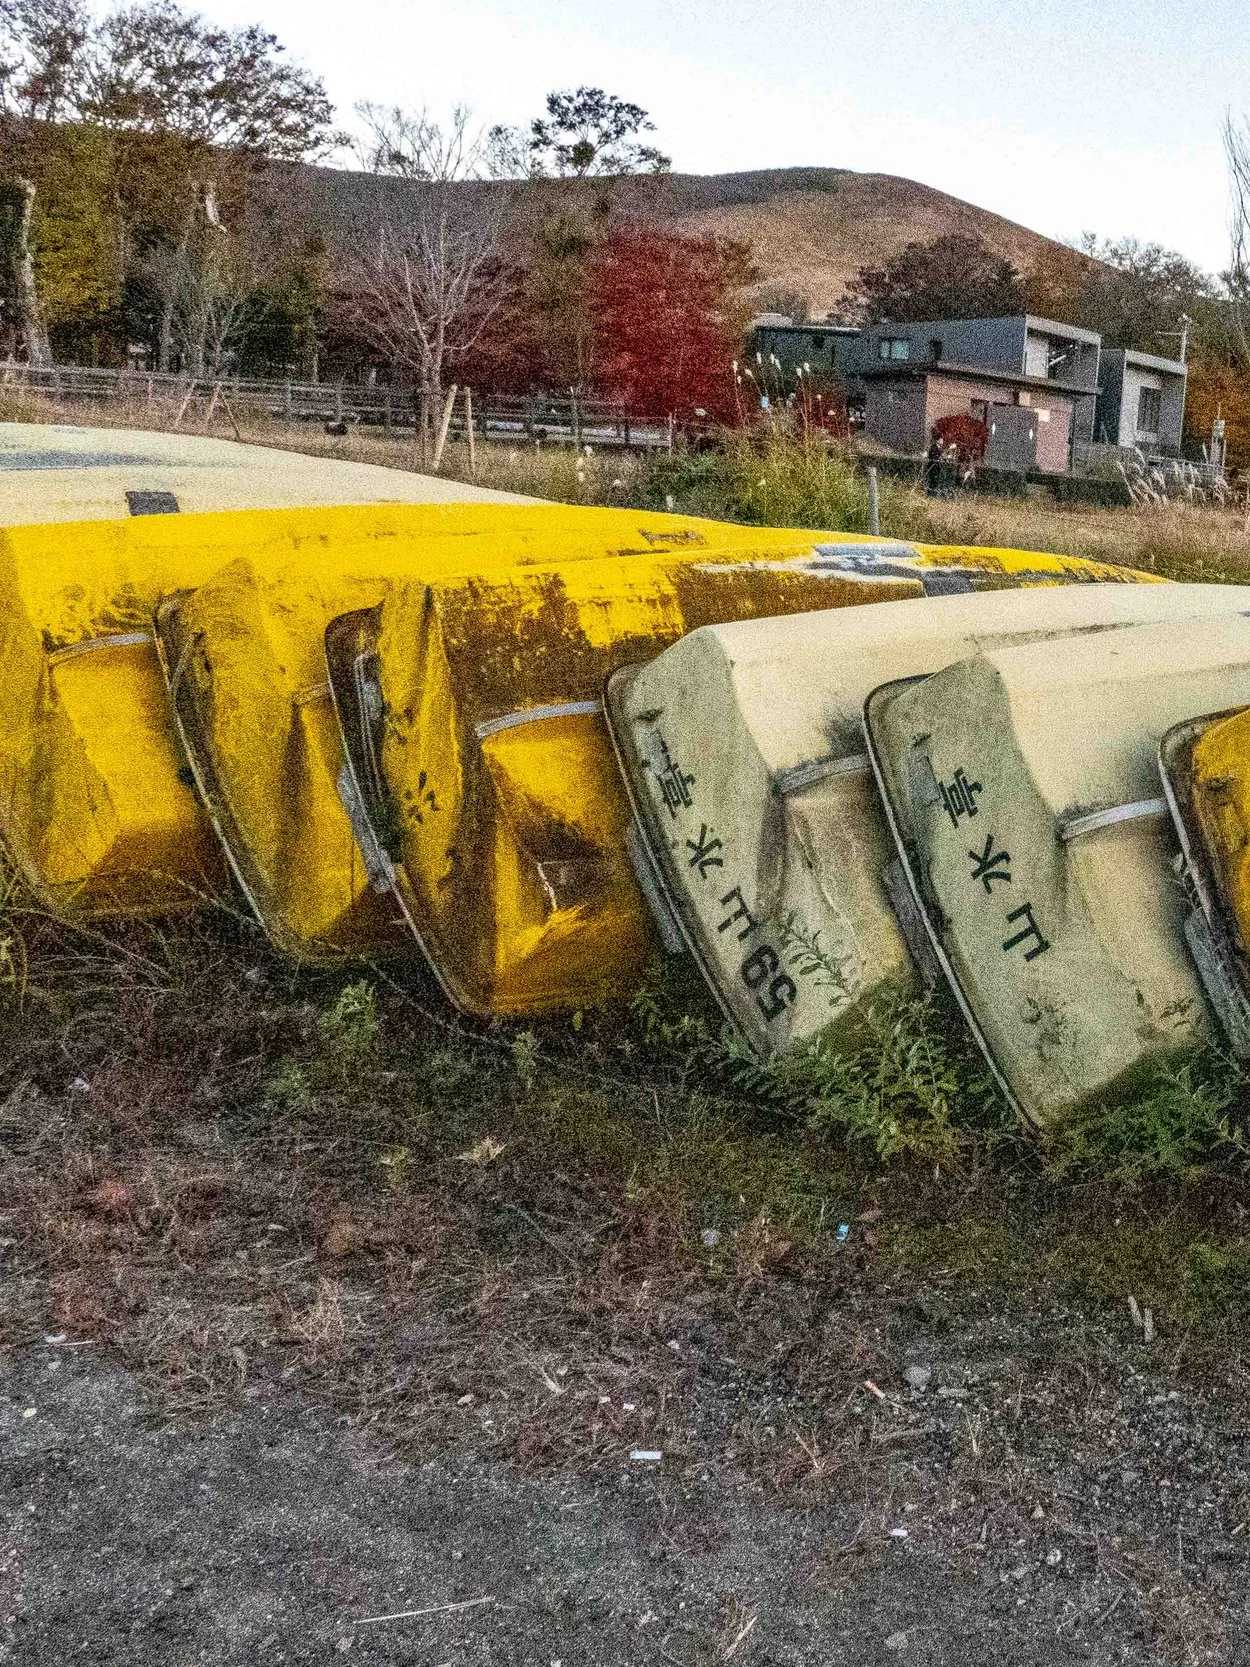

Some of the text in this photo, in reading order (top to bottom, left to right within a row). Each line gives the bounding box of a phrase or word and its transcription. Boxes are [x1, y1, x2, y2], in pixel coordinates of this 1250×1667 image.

[938, 766, 1051, 963] 山水亭
[741, 945, 797, 1022] 59
